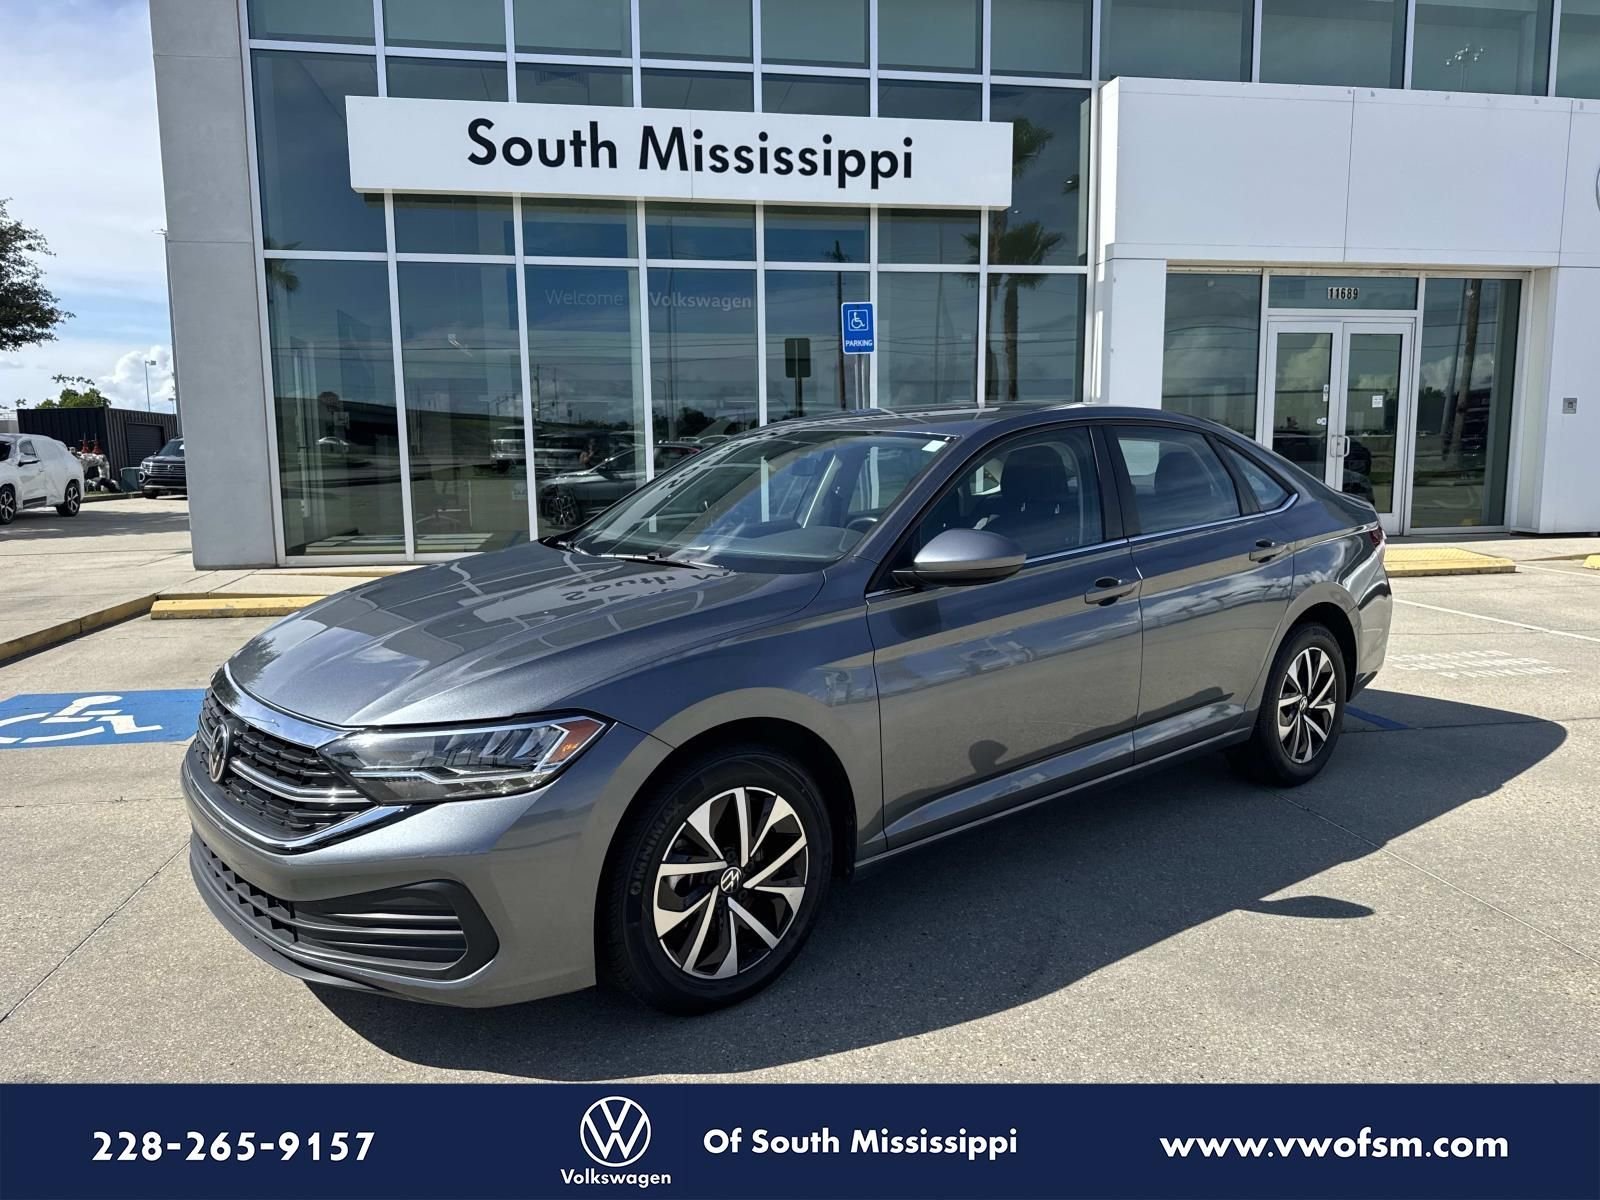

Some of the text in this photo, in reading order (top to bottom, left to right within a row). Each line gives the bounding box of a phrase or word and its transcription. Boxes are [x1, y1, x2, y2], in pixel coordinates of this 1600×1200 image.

[467, 117, 913, 190] South Mississippi
[545, 289, 752, 311] Welcome Volkswagen
[1328, 287, 1359, 300] 11689
[845, 339, 873, 347] PARKING
